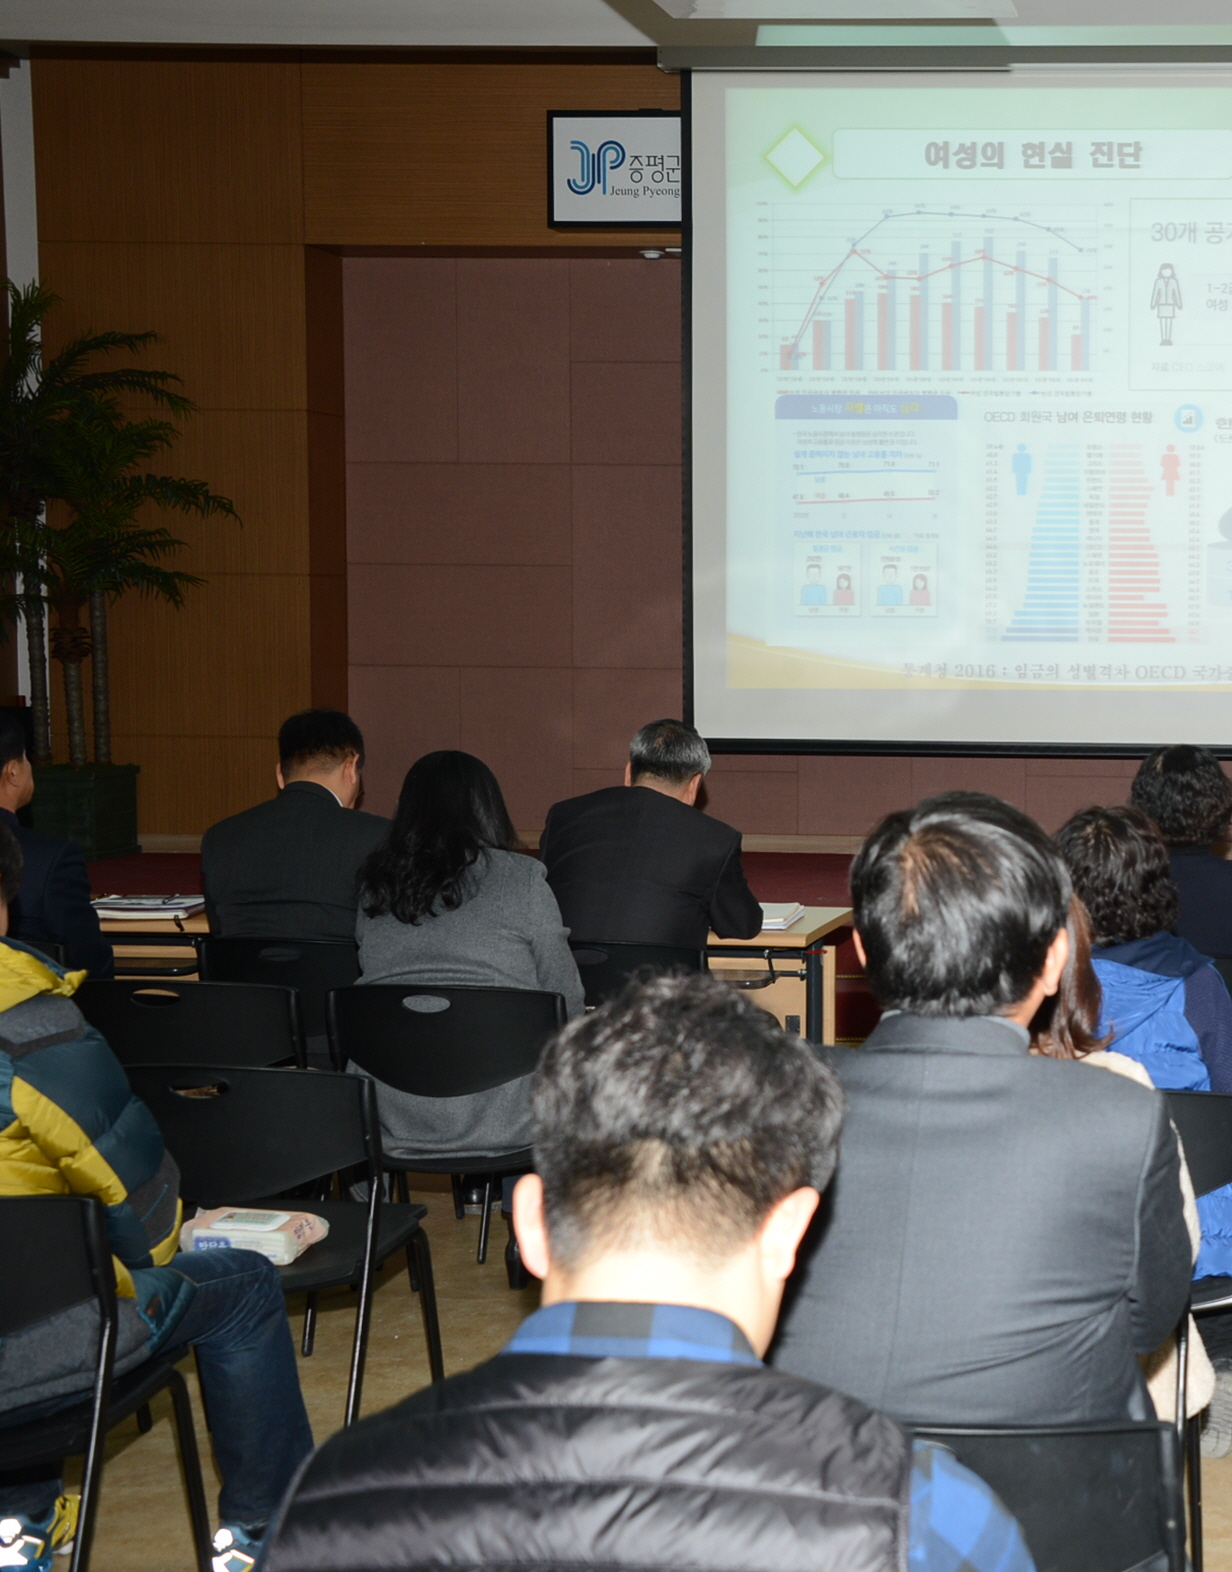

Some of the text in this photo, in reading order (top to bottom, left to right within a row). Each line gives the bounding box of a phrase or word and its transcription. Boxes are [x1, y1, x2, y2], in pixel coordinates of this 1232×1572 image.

[925, 141, 1142, 169] 여성의 현실 진단
[629, 155, 680, 183] 증평군
[610, 186, 680, 198] Jeung Pyeong
[1151, 221, 1197, 244] 30개
[1206, 298, 1228, 311] 여성
[984, 411, 1153, 423] OECD 회원국 남여 은퇴연령 현황
[954, 664, 996, 679] 2016
[1014, 664, 1060, 680] 임금의
[1068, 664, 1130, 680] 성별격차
[1135, 666, 1186, 680] OECD
